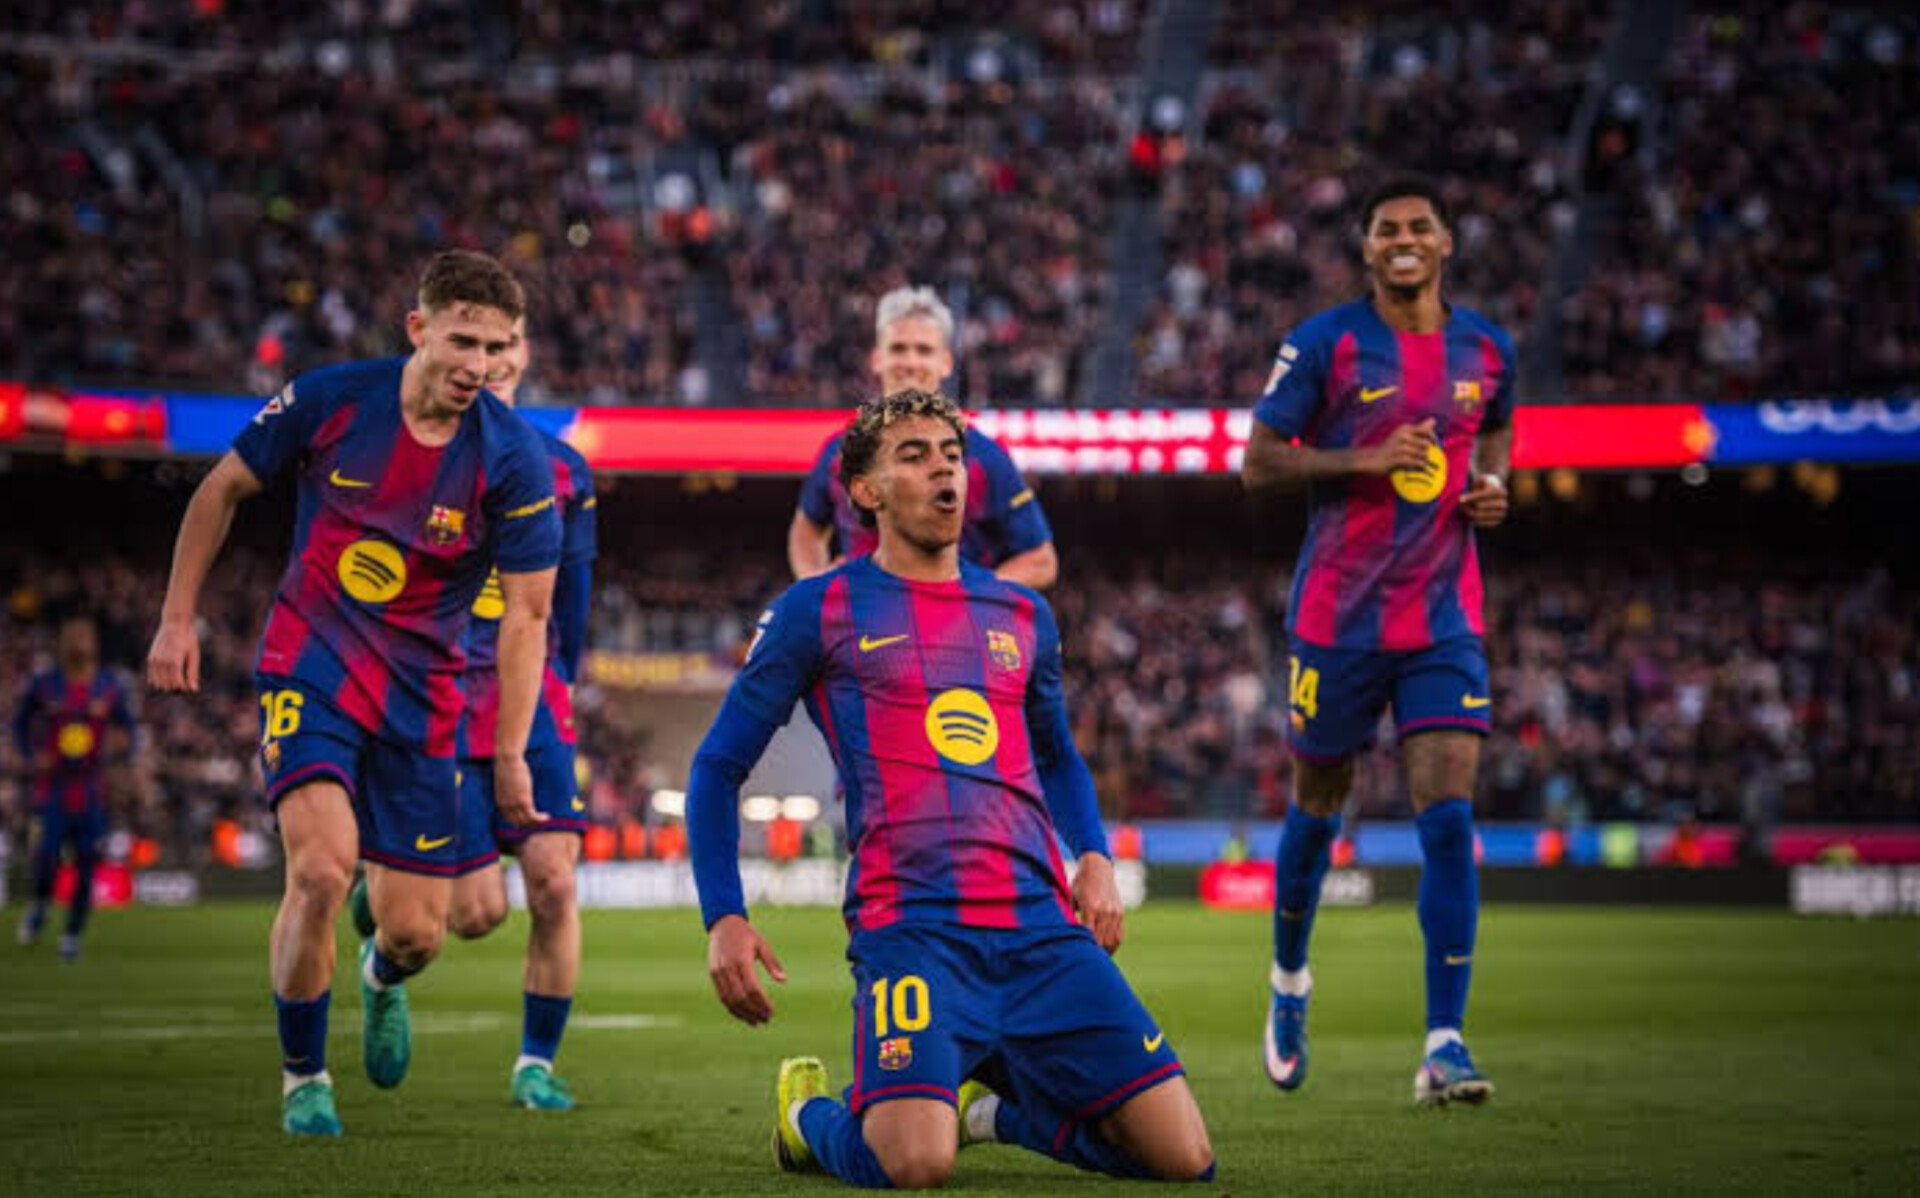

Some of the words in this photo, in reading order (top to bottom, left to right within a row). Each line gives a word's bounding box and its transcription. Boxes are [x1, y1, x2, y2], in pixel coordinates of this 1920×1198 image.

[261, 690, 303, 746] 16
[1290, 656, 1319, 718] 14
[872, 975, 931, 1037] 10
